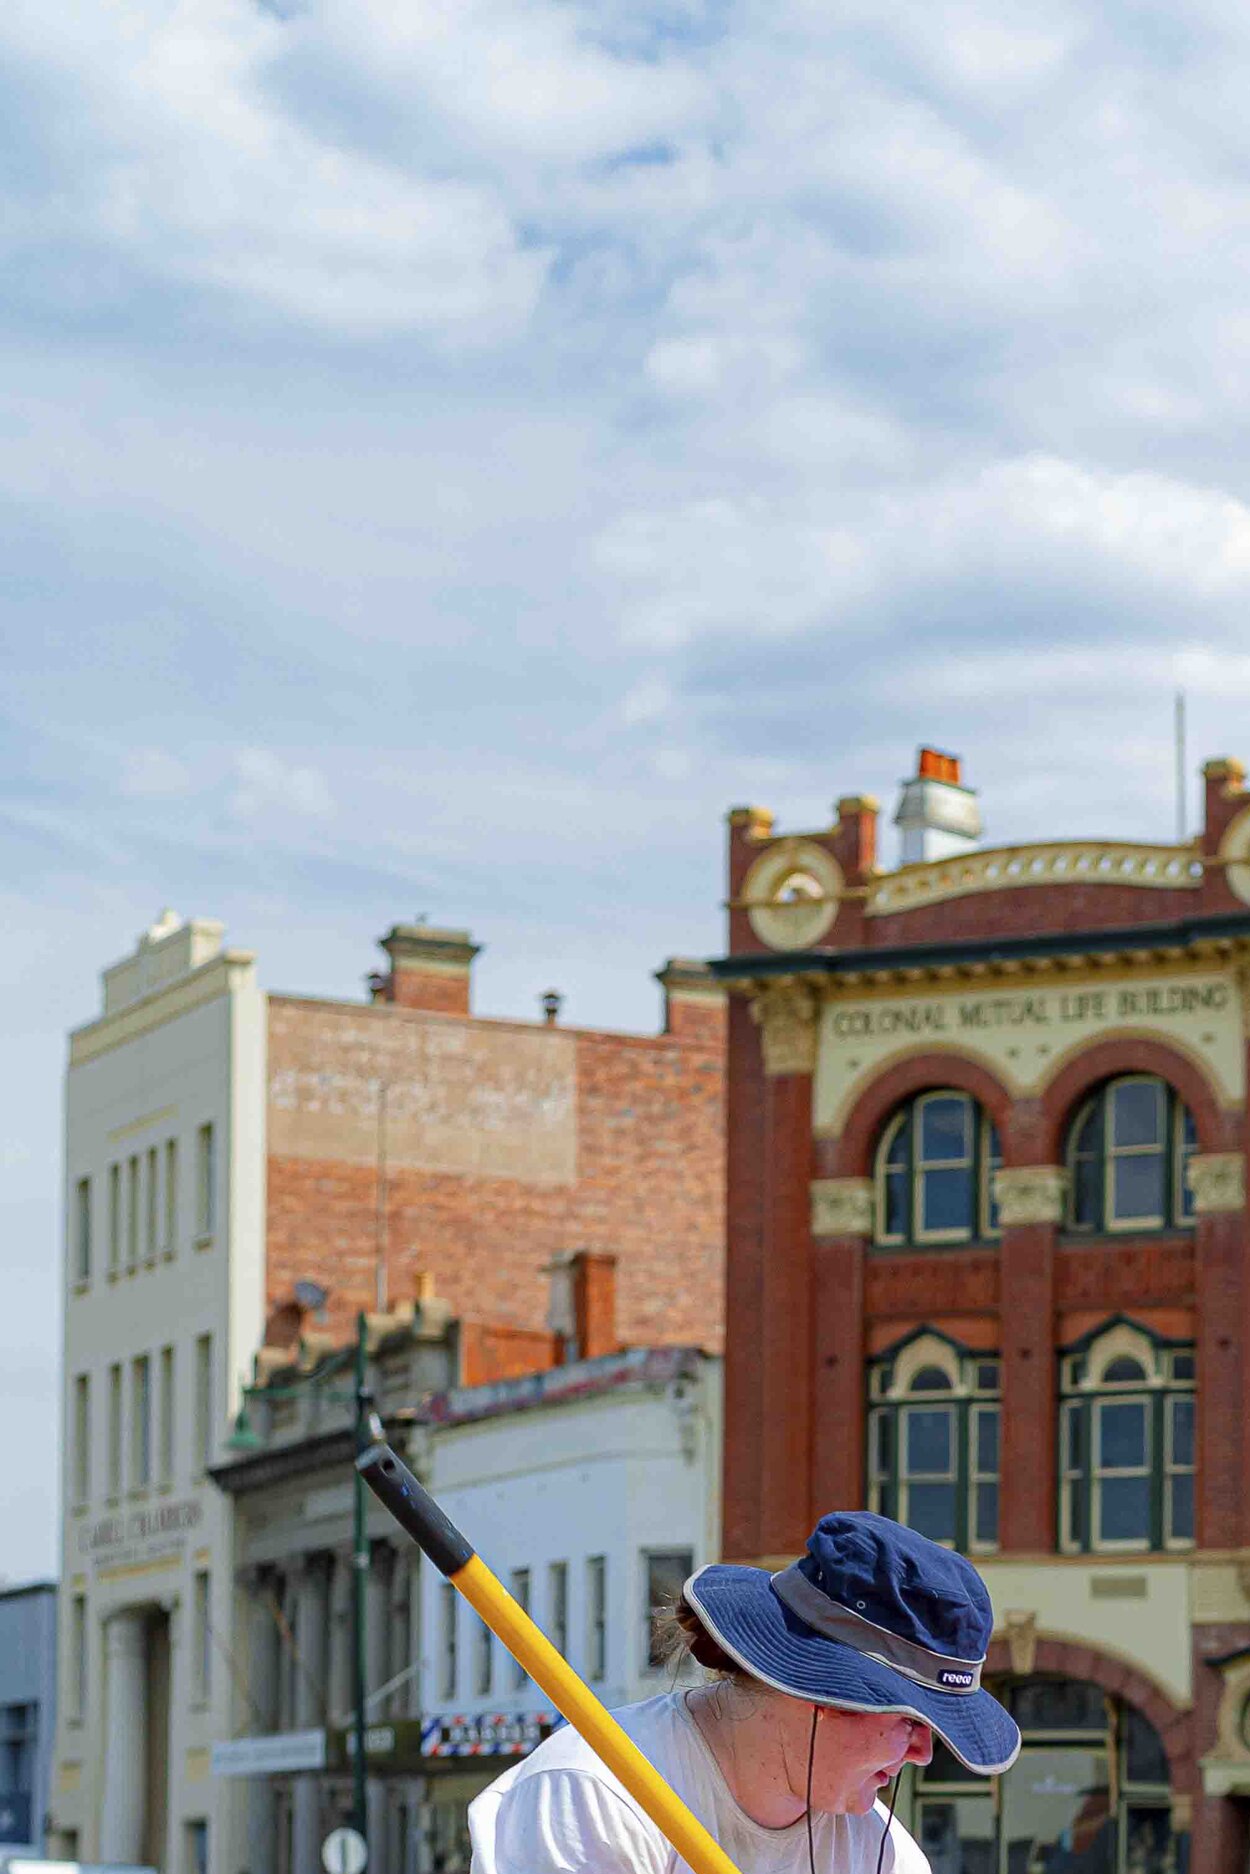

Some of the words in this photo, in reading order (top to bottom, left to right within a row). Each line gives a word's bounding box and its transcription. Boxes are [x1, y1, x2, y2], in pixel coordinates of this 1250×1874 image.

[833, 1003, 946, 1040] COLONIAL
[959, 996, 1049, 1030] MUTUAL
[1059, 990, 1106, 1022] LIFE
[1116, 983, 1230, 1018] BUILDING
[942, 1672, 972, 1685] reece
